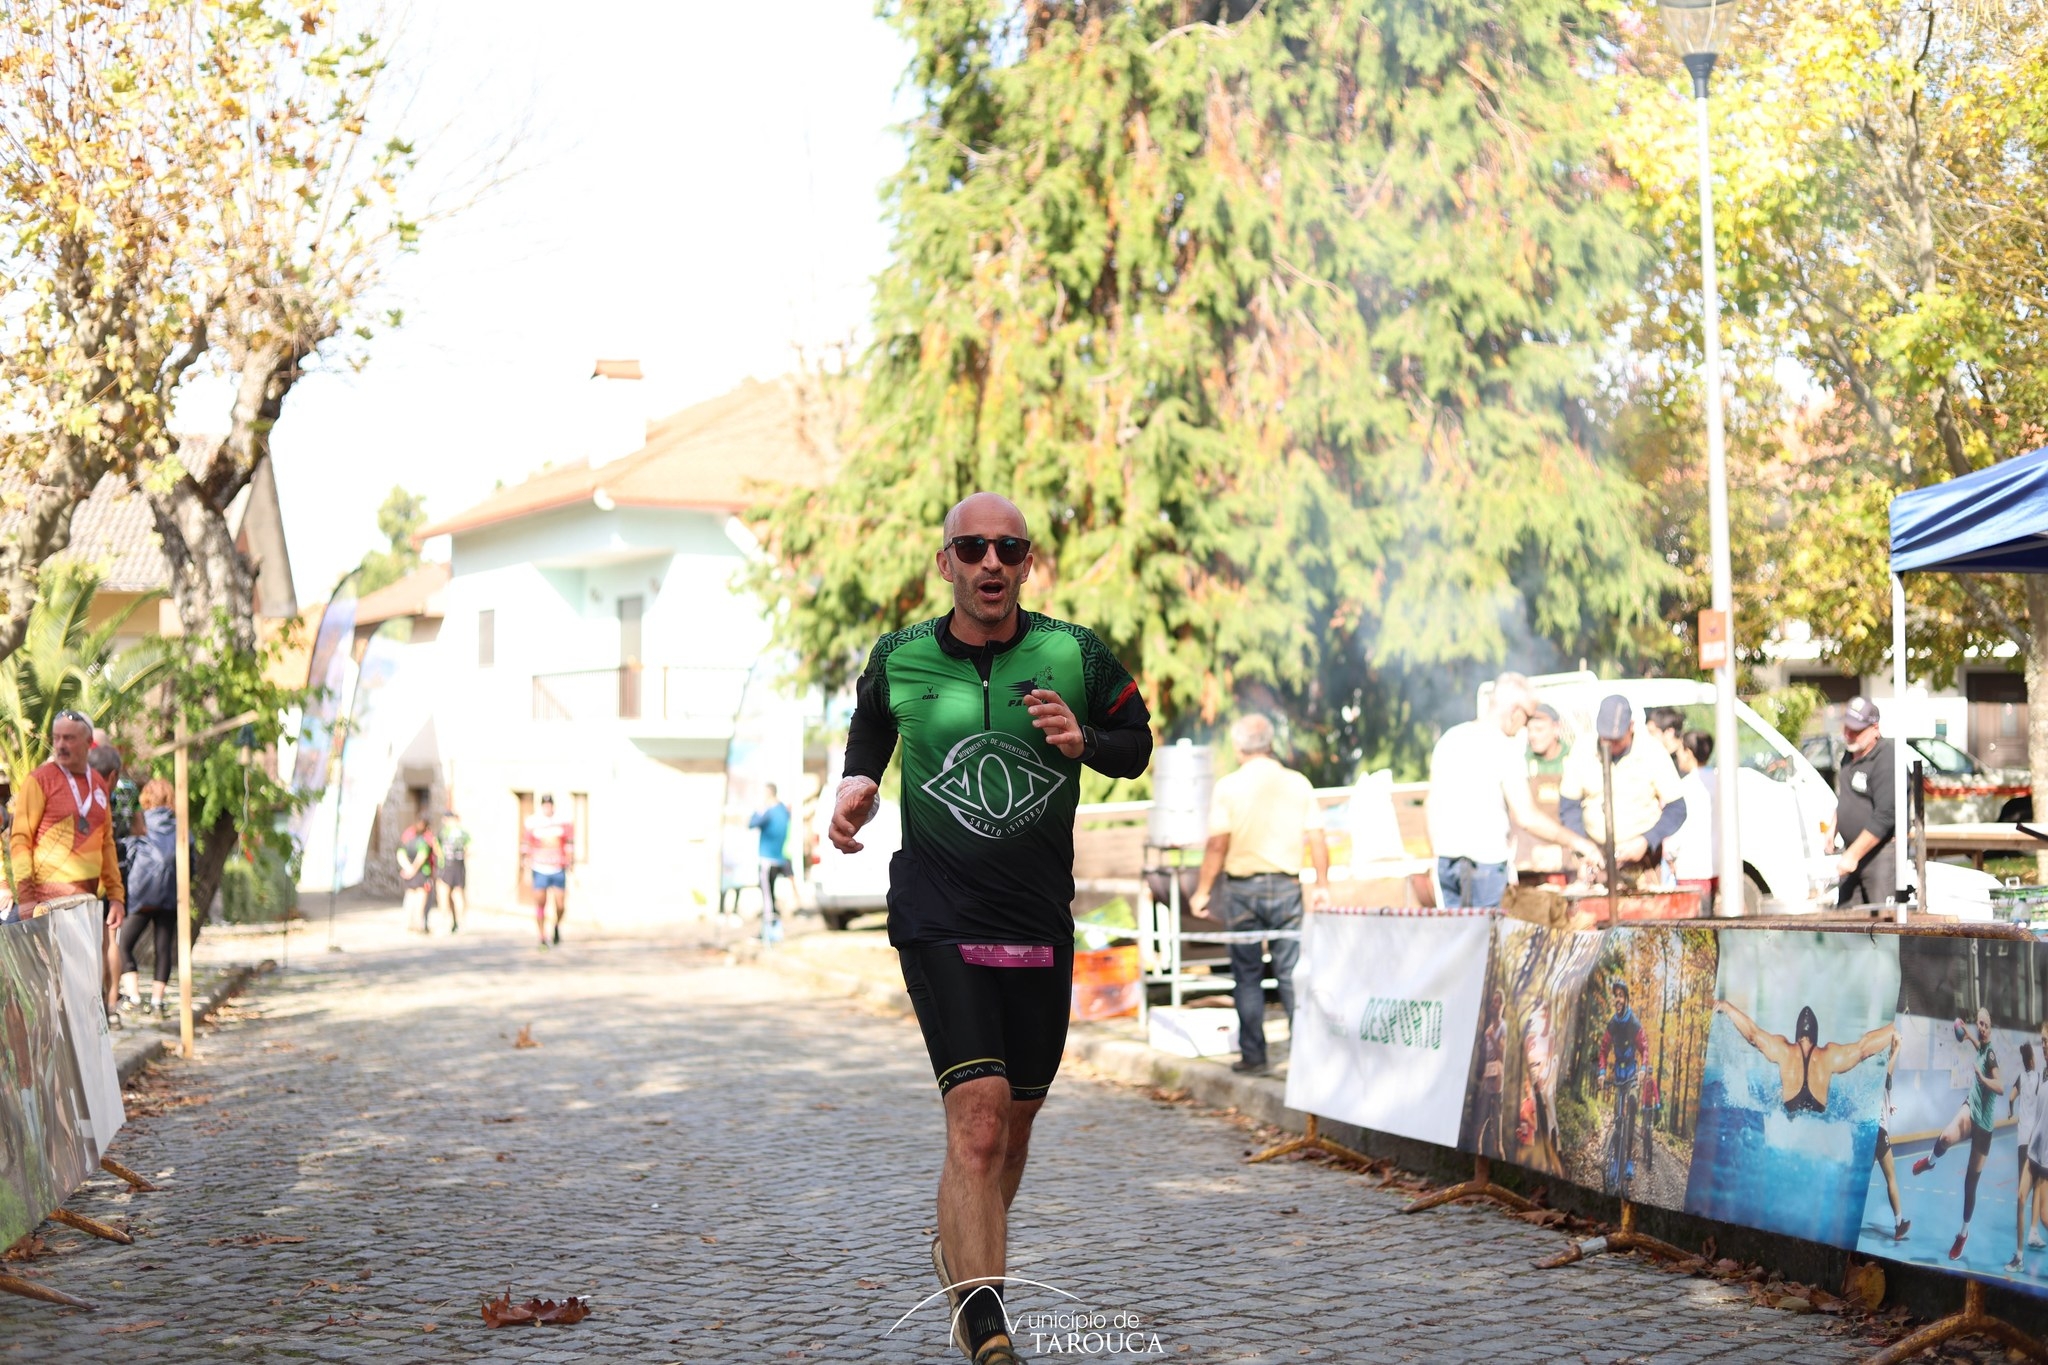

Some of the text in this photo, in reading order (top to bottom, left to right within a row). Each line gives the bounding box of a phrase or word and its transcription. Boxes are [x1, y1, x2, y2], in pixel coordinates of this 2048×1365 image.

[957, 737, 1031, 760] MOVIMENTO DE JUVENTUDE
[969, 807, 1041, 837] SANTO ISIDORO
[1359, 997, 1442, 1051] DESPORTO
